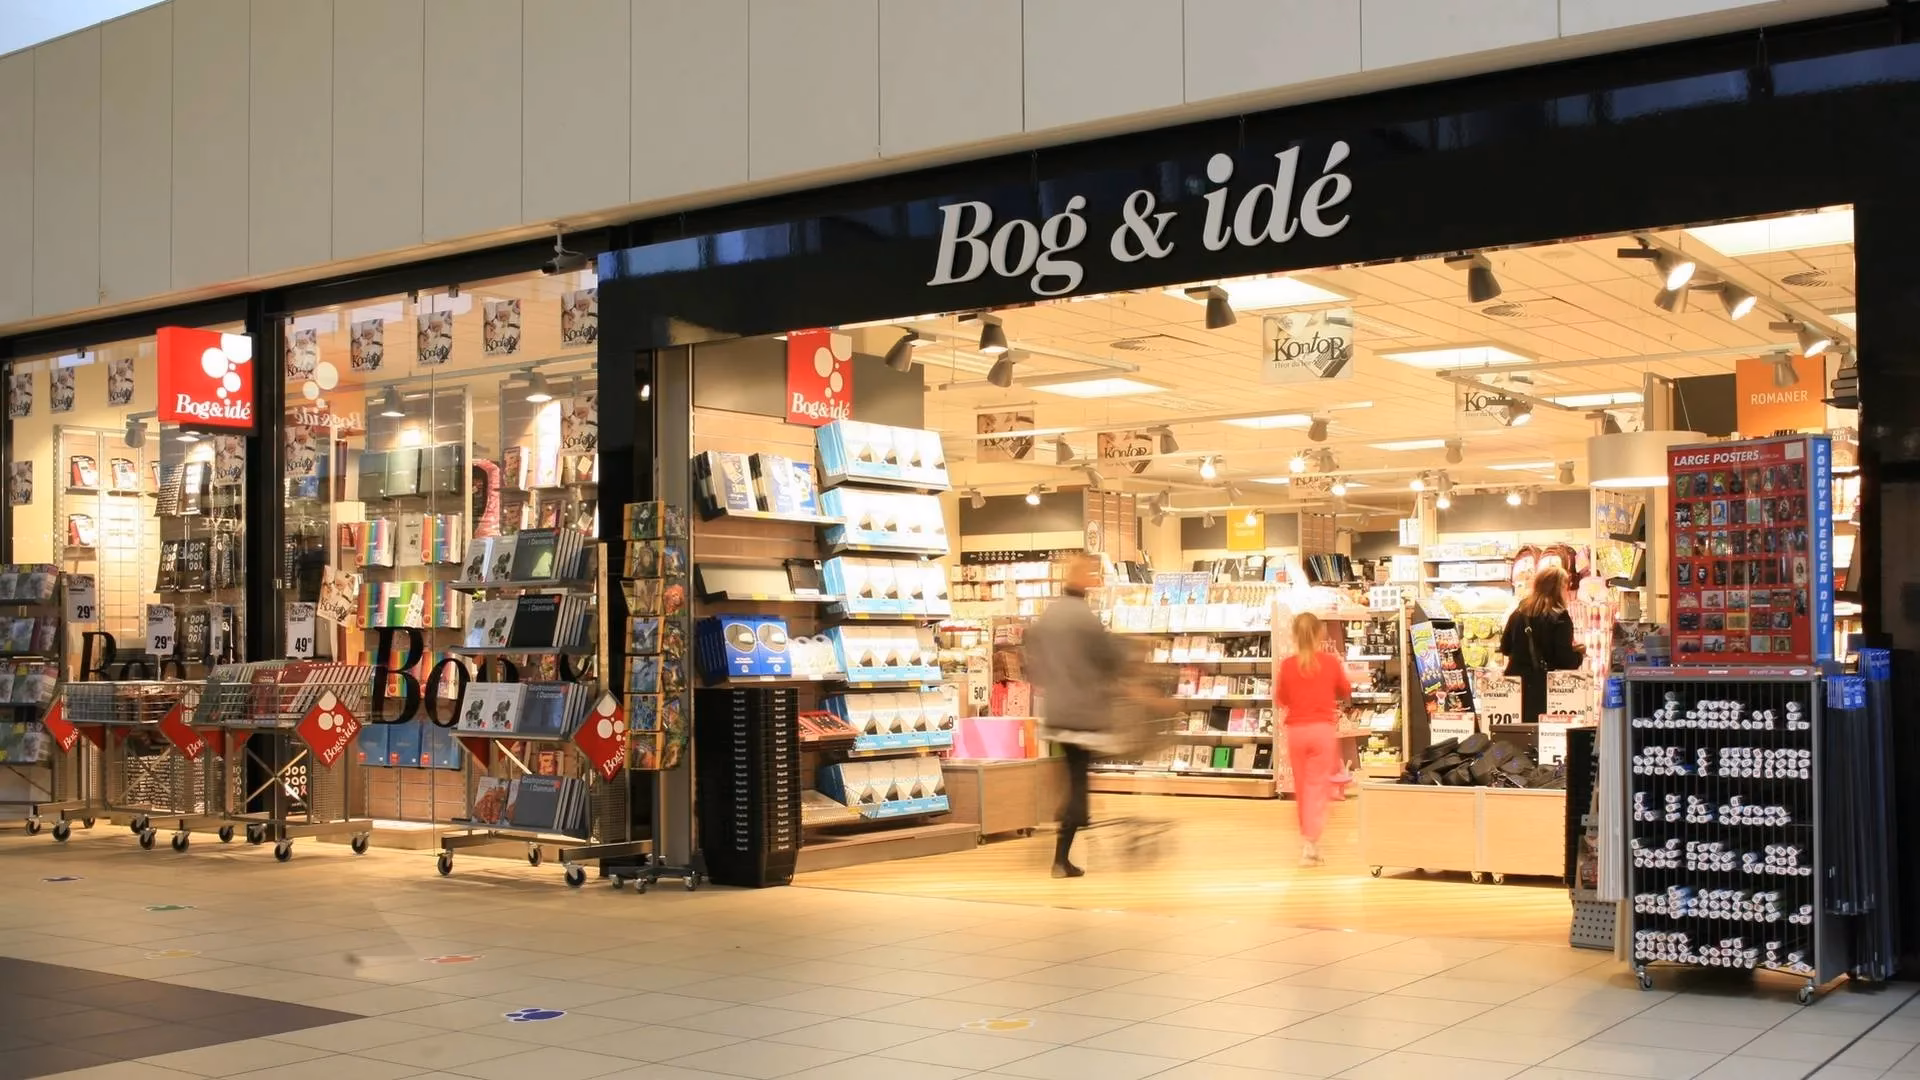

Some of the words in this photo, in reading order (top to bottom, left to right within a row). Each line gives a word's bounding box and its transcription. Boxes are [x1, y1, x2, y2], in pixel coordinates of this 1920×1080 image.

[926, 195, 1088, 296] Bog
[1110, 189, 1178, 263] &
[1202, 140, 1353, 252] idé
[175, 394, 251, 420] Bog&idé
[793, 392, 850, 420] Bog&idé
[1750, 390, 1809, 405] ROMANER
[1674, 453, 1710, 466] LARGE
[1713, 450, 1760, 464] POSTERS
[1816, 444, 1827, 511] FORNYE
[1818, 517, 1828, 584] VEGGEN
[1820, 590, 1829, 634] DIN!
[295, 637, 307, 652] 49
[323, 719, 358, 765] Bog&idé
